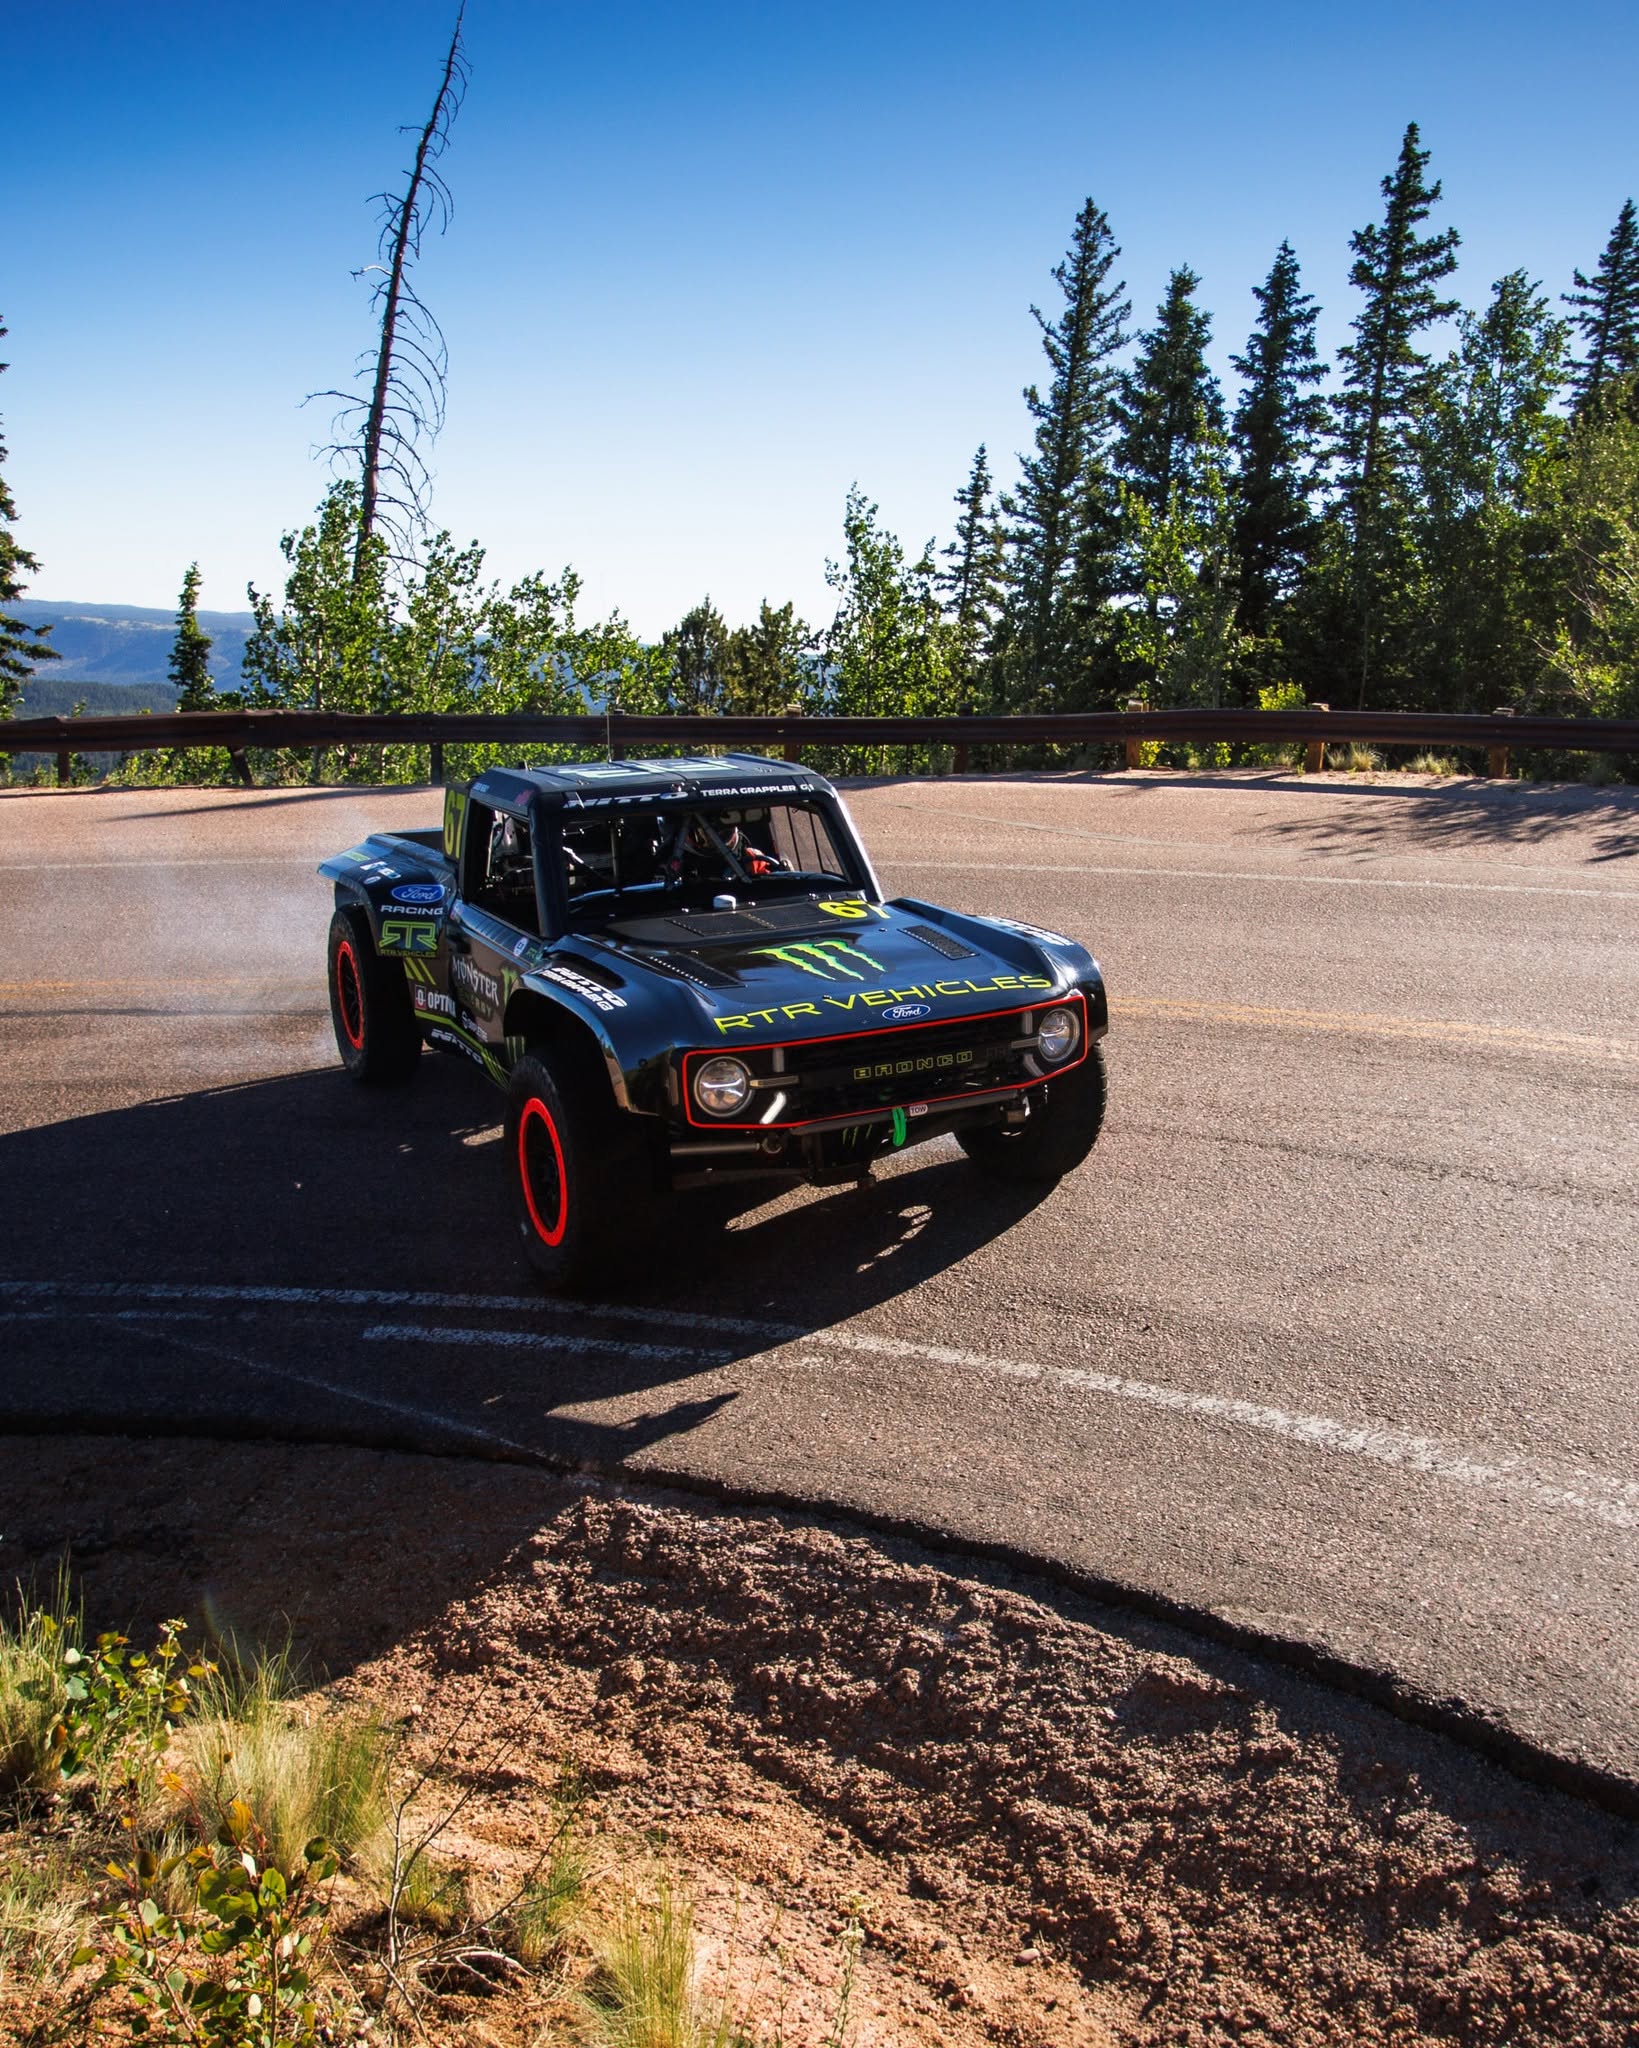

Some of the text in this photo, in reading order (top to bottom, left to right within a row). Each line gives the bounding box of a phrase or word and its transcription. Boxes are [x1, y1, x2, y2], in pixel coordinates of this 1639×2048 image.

[700, 789, 740, 799] TERRA
[740, 784, 796, 797] GRAPPLER
[444, 790, 466, 859] 67
[400, 886, 440, 900] Ford
[380, 904, 444, 916] RACING
[816, 899, 892, 919] 67
[452, 954, 500, 1007] MONSTER
[713, 972, 1052, 1036] RTR VEHICLES
[892, 1004, 922, 1018] Ford
[852, 1050, 974, 1080] BRONCO
[910, 1106, 927, 1115] TOW
